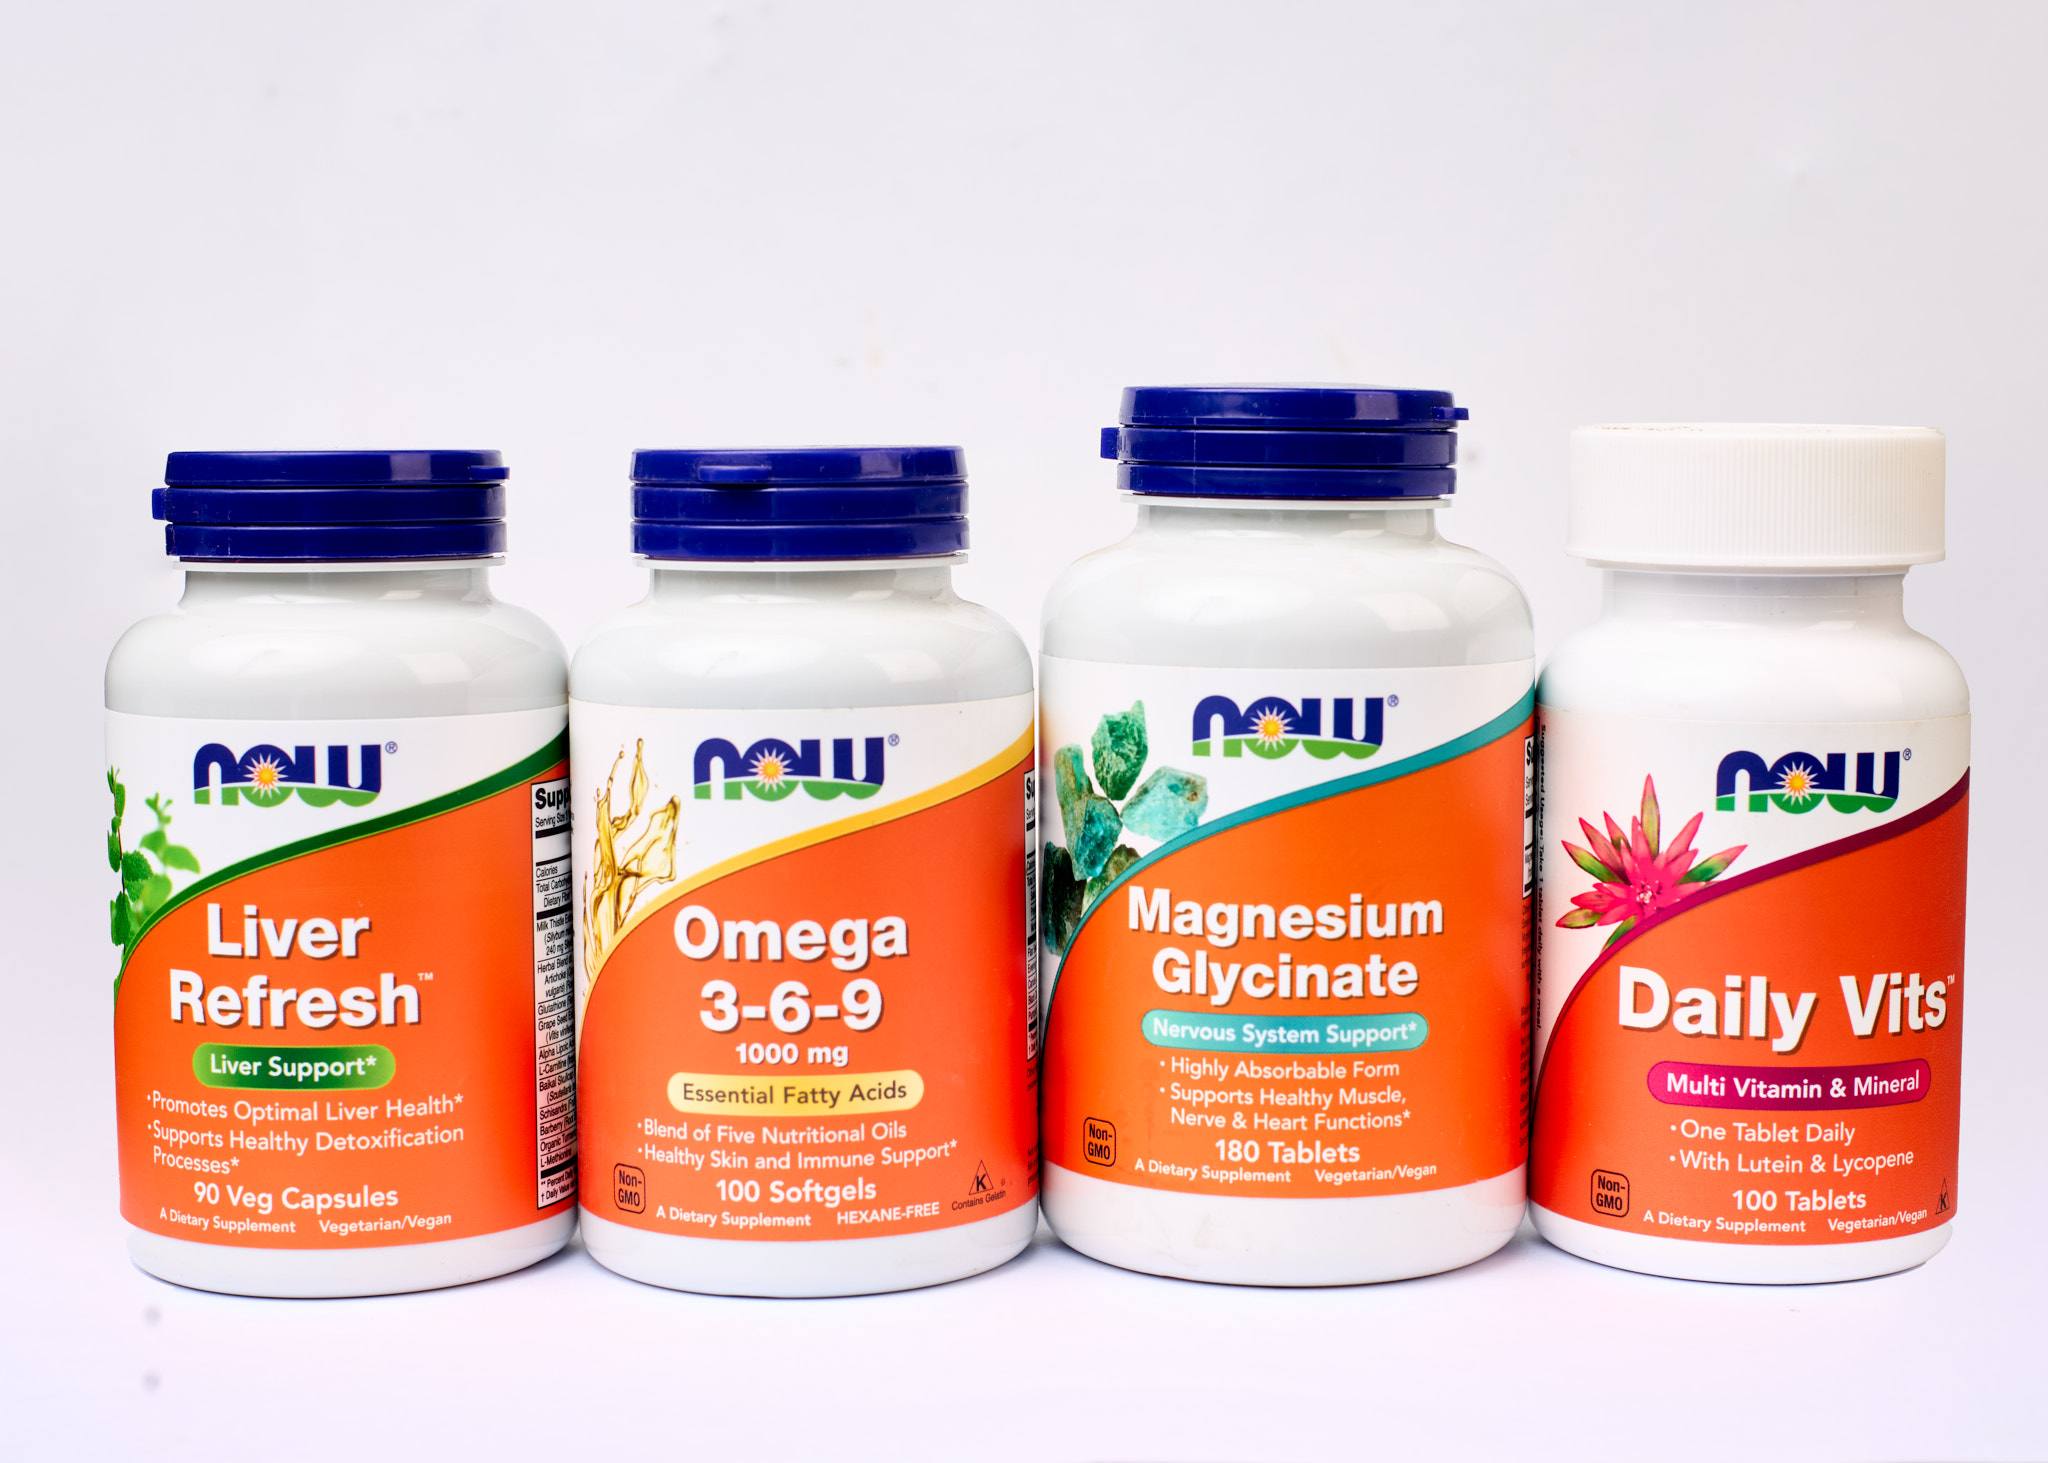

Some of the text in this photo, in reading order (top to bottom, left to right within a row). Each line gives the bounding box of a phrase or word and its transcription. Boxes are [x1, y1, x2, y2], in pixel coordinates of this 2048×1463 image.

[536, 865, 558, 879] Calories
[536, 882, 550, 894] Total
[544, 894, 561, 908] Dietary
[537, 921, 548, 932] Milk
[1129, 886, 1442, 947] Magnesium
[208, 903, 369, 957] Liver
[674, 905, 907, 970] Omega
[537, 960, 556, 974] Herbal
[1153, 947, 1417, 1005] Glycinate
[700, 979, 881, 1032] 3-6-9
[1619, 966, 1816, 1051] Daily
[538, 1017, 556, 1032] Grape
[1150, 1017, 1235, 1041] Nervous
[1242, 1023, 1319, 1048] System
[211, 1053, 261, 1075] Liver
[539, 1047, 555, 1061] Alpha
[736, 1043, 848, 1067] 1000 mg
[1172, 1056, 1399, 1082] Highly Absorbable Form
[540, 1078, 557, 1092] Baikal
[684, 1080, 906, 1108] Essential Fatty Acids
[1171, 1082, 1405, 1110] Supports Healthy Muscle,
[1667, 1070, 1919, 1098] Multi Vitamin & Mineral
[153, 1090, 228, 1118] Promotes
[234, 1100, 318, 1126] Optimal
[327, 1102, 378, 1120] Liver
[1171, 1107, 1226, 1128] Nerve
[1232, 1112, 1247, 1129] &
[1254, 1113, 1307, 1130] Heart
[153, 1121, 464, 1156] Supports Healthy Detoxification
[644, 1118, 907, 1144] Blend of Five Nutritional Oils
[1089, 1123, 1113, 1142] Non-
[1681, 1119, 1855, 1146] One Tablet Daily
[540, 1135, 561, 1153] Organic
[1088, 1141, 1111, 1161] GMO
[1216, 1139, 1360, 1163] 180 Tablets
[645, 1143, 704, 1171] Healthy
[710, 1149, 748, 1168] Skin
[755, 1152, 790, 1169] and
[798, 1152, 875, 1168] Immune
[1680, 1149, 1913, 1177] With Lutein & Lycopene
[619, 1169, 642, 1190] Non-
[976, 1173, 986, 1191] K
[1135, 1158, 1290, 1184] A Dietary Supplement
[1314, 1165, 1436, 1185] Vegetarian/Vegan
[716, 1177, 876, 1208] 100 Softgels
[1598, 1175, 1626, 1194] Non-
[194, 1182, 398, 1215] 90 Veg Capsules
[618, 1190, 641, 1208] GMO
[951, 1197, 984, 1211] Contains
[1596, 1193, 1623, 1211] GMO
[1733, 1189, 1866, 1211] 100 Tablets
[160, 1208, 296, 1233] A Dietary Supplement
[656, 1205, 811, 1229] A Dietary Supplement
[837, 1202, 940, 1224] HEXANE-FREE
[1643, 1210, 1805, 1235] A Dietary Supplement
[1828, 1210, 1927, 1233] Vegetarian/Vegan
[319, 1215, 451, 1236] Vegetarian/Vegan
